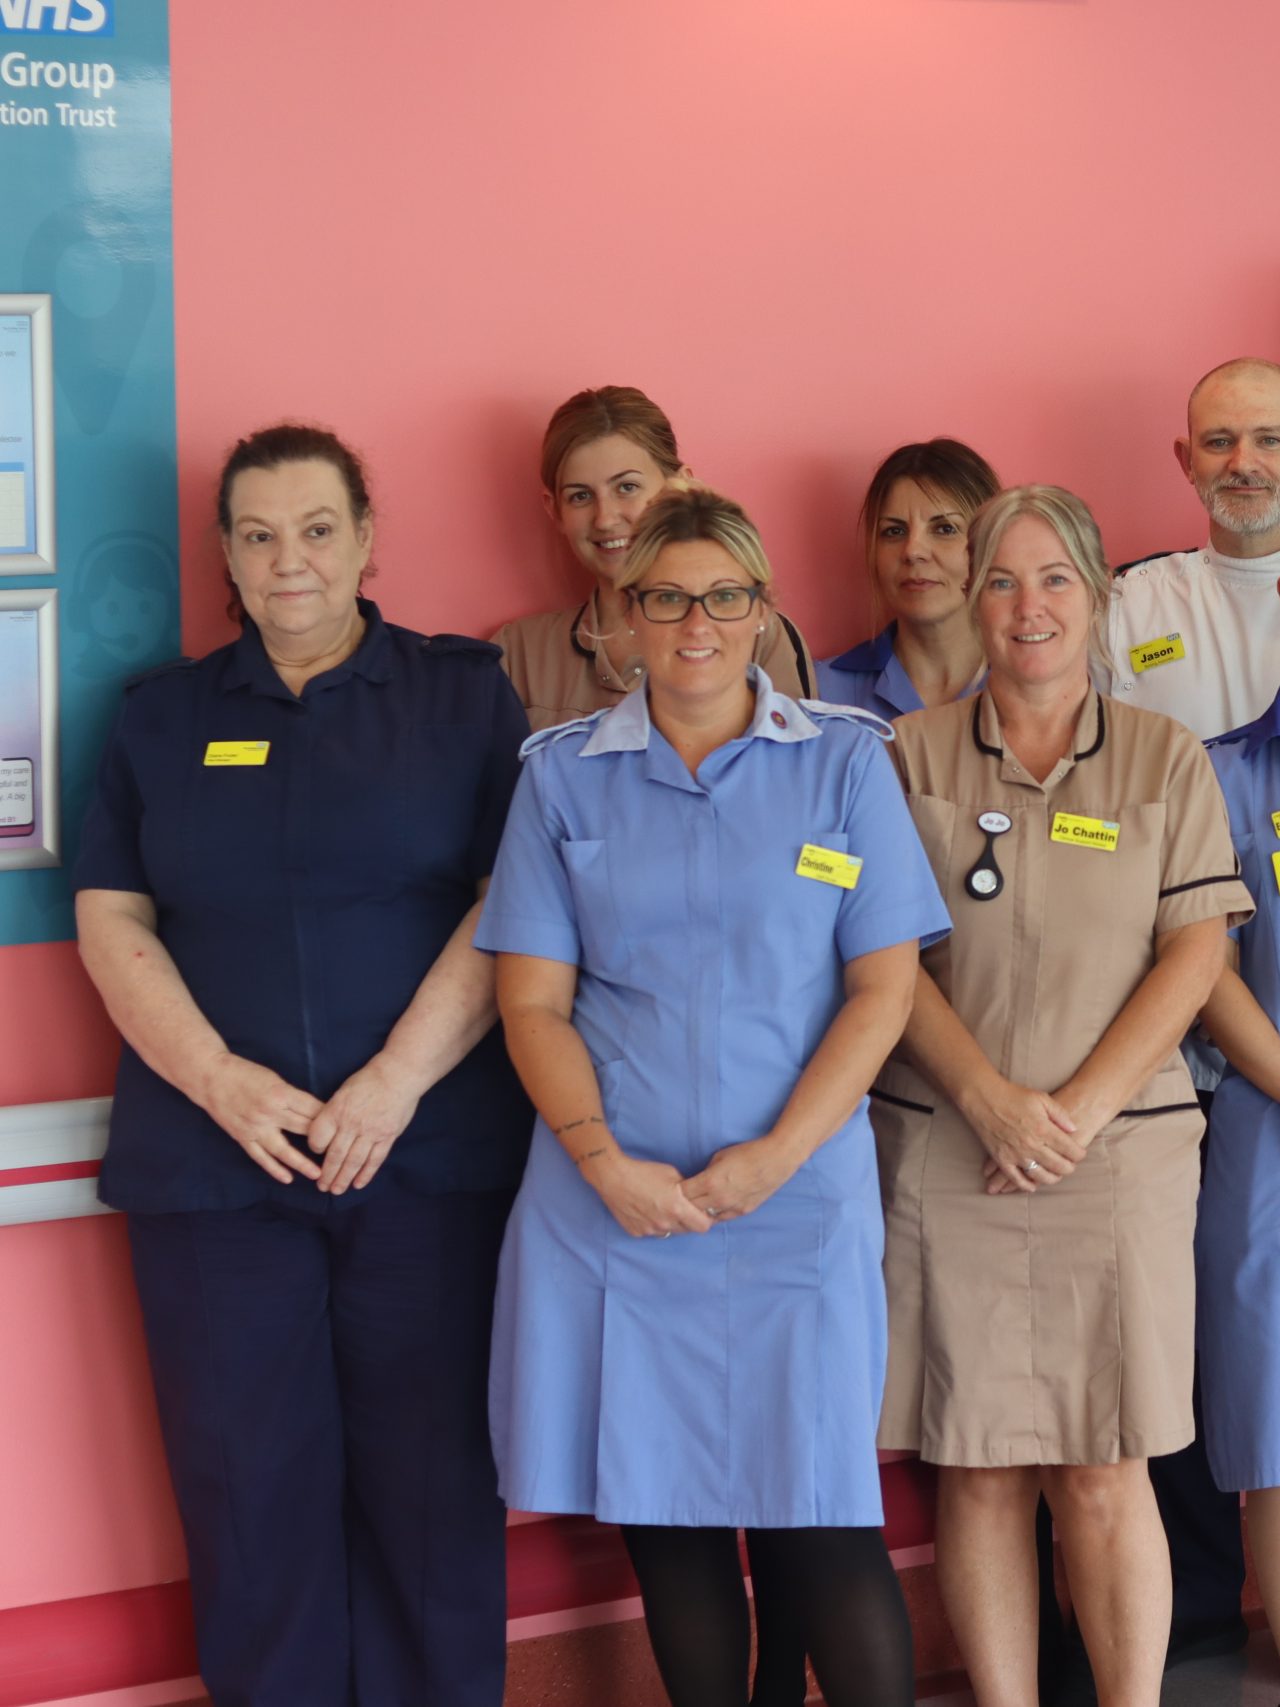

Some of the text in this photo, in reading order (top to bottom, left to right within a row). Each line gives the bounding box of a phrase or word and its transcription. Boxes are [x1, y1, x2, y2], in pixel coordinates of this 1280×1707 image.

[1, 52, 115, 98] Group
[56, 103, 117, 127] Trust
[1140, 646, 1174, 663] Jason
[1054, 823, 1069, 834] Jo
[1072, 826, 1116, 843] Chattin
[801, 855, 834, 874] Christine
